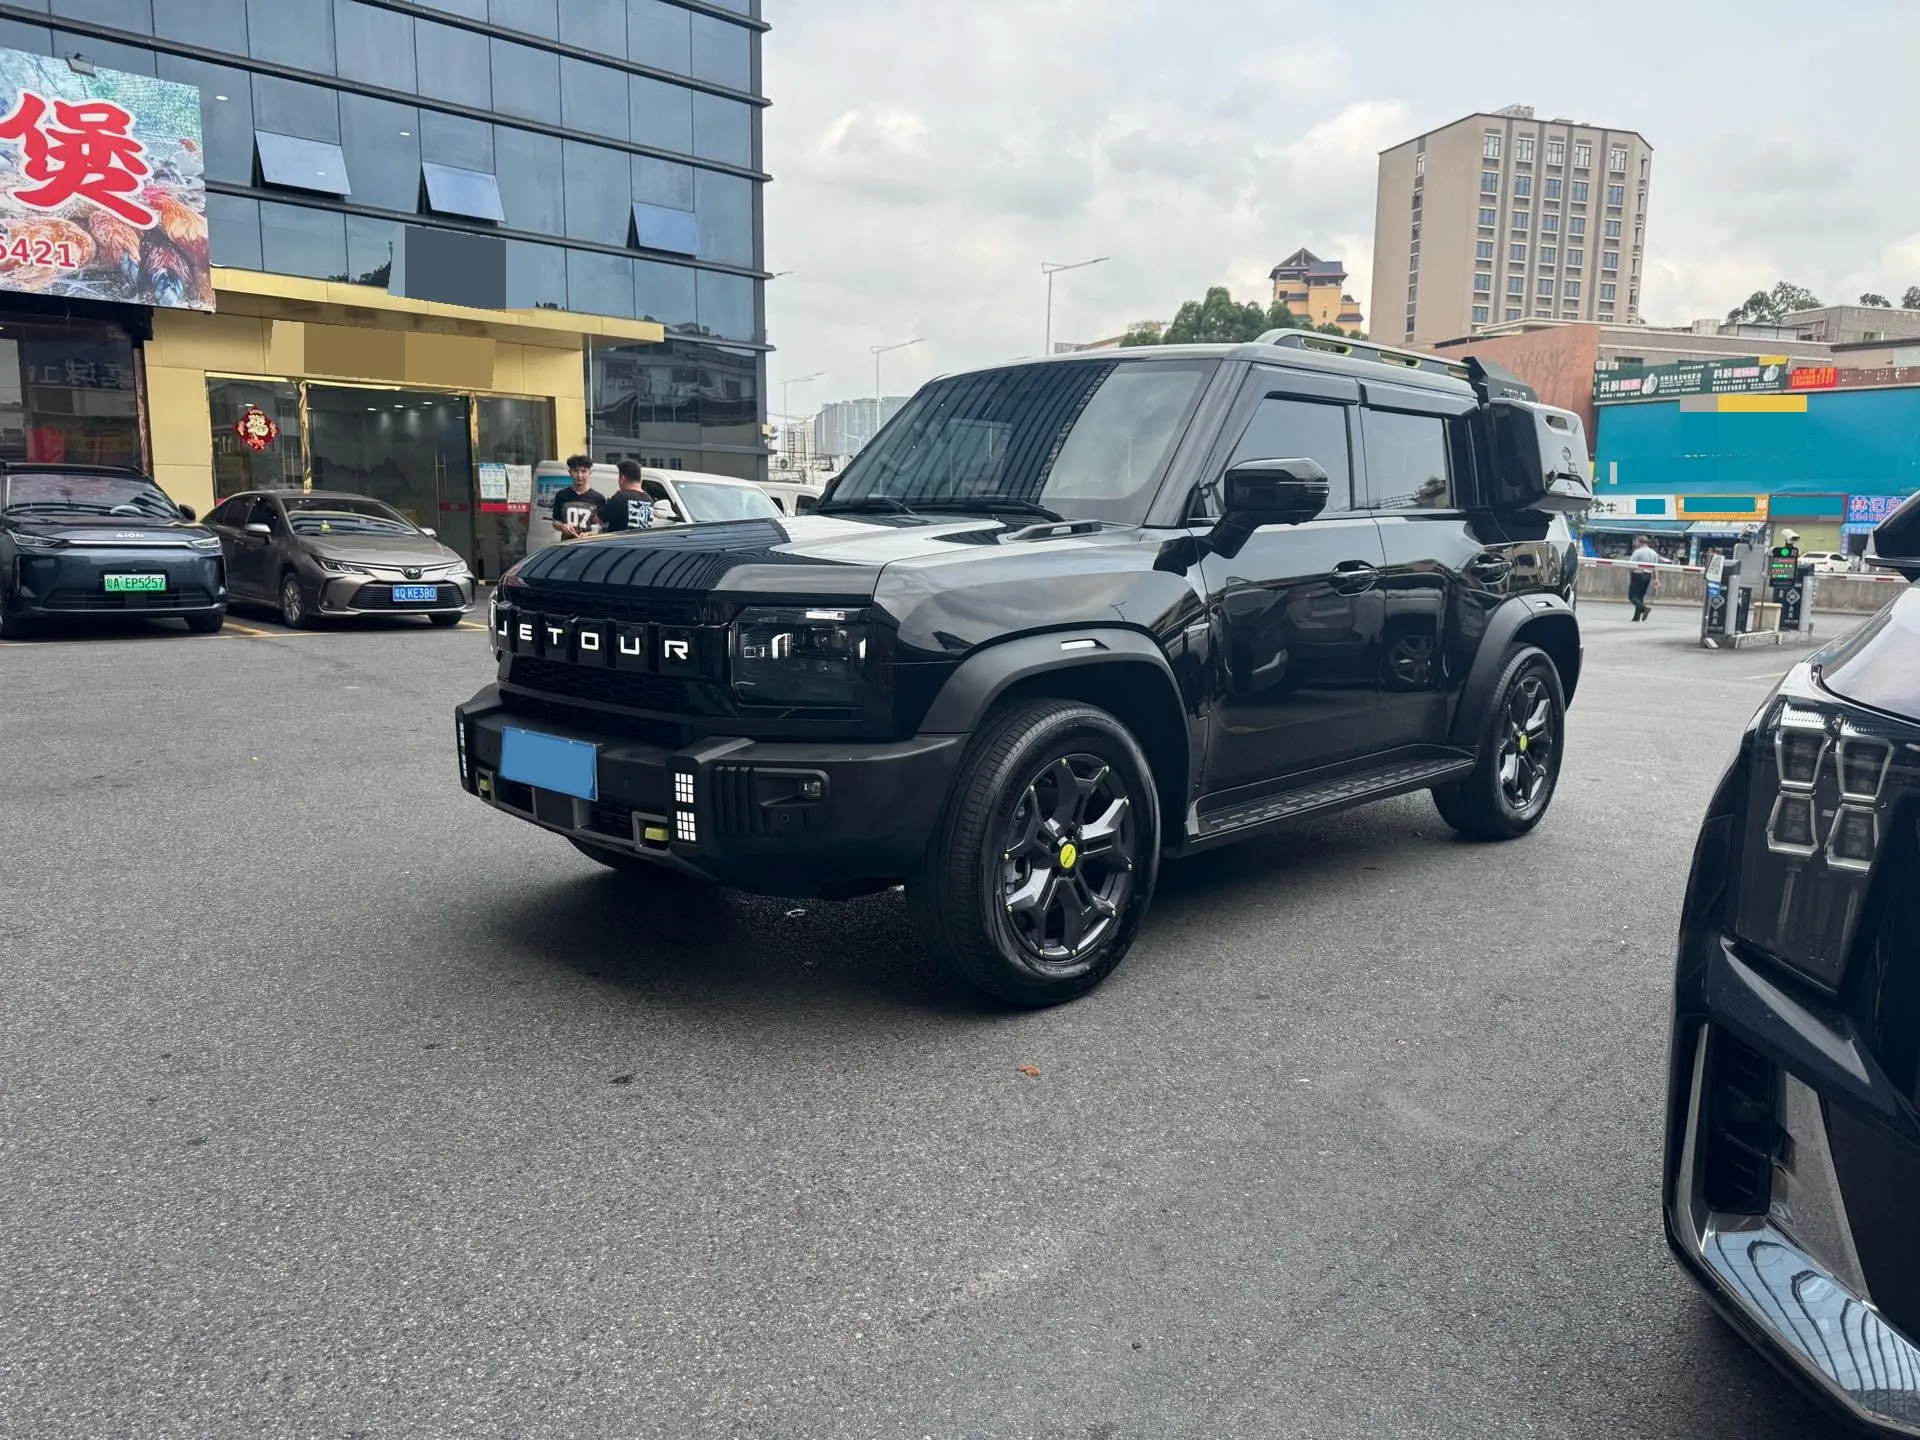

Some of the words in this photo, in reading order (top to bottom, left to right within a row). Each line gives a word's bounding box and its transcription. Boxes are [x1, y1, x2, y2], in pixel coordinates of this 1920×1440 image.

[0, 93, 153, 225] 煲
[566, 507, 592, 528] 07
[125, 577, 164, 589] EP5257
[498, 621, 689, 660] JETOUR
